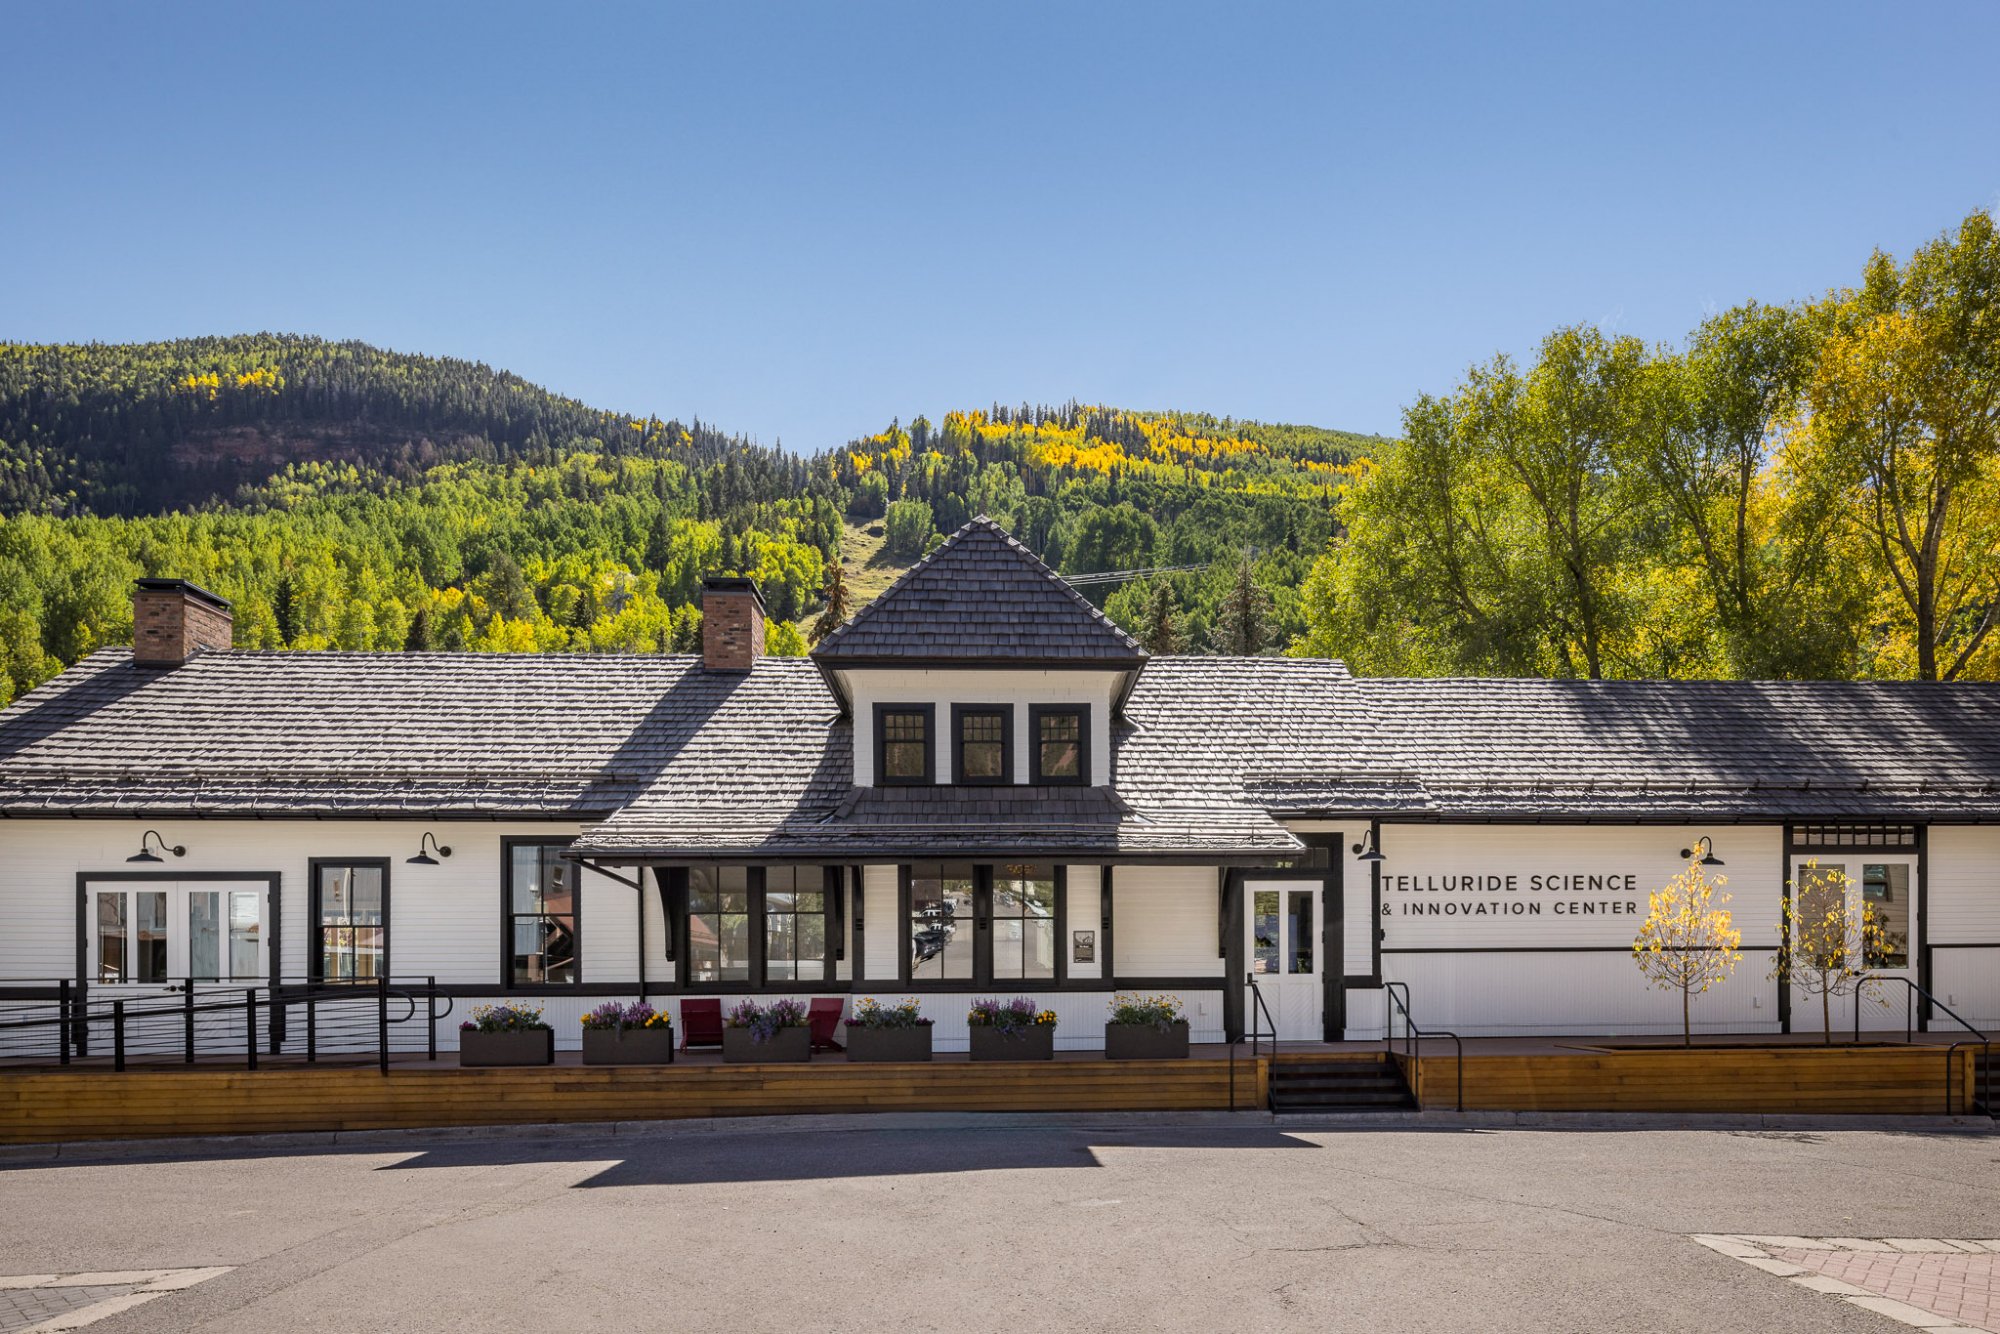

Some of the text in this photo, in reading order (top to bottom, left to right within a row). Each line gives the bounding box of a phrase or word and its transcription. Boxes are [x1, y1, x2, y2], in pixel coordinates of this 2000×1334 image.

[1381, 874, 1637, 892] TELLURIDE SCIENCE
[1381, 901, 1637, 916] & INNOVATION CENTER
